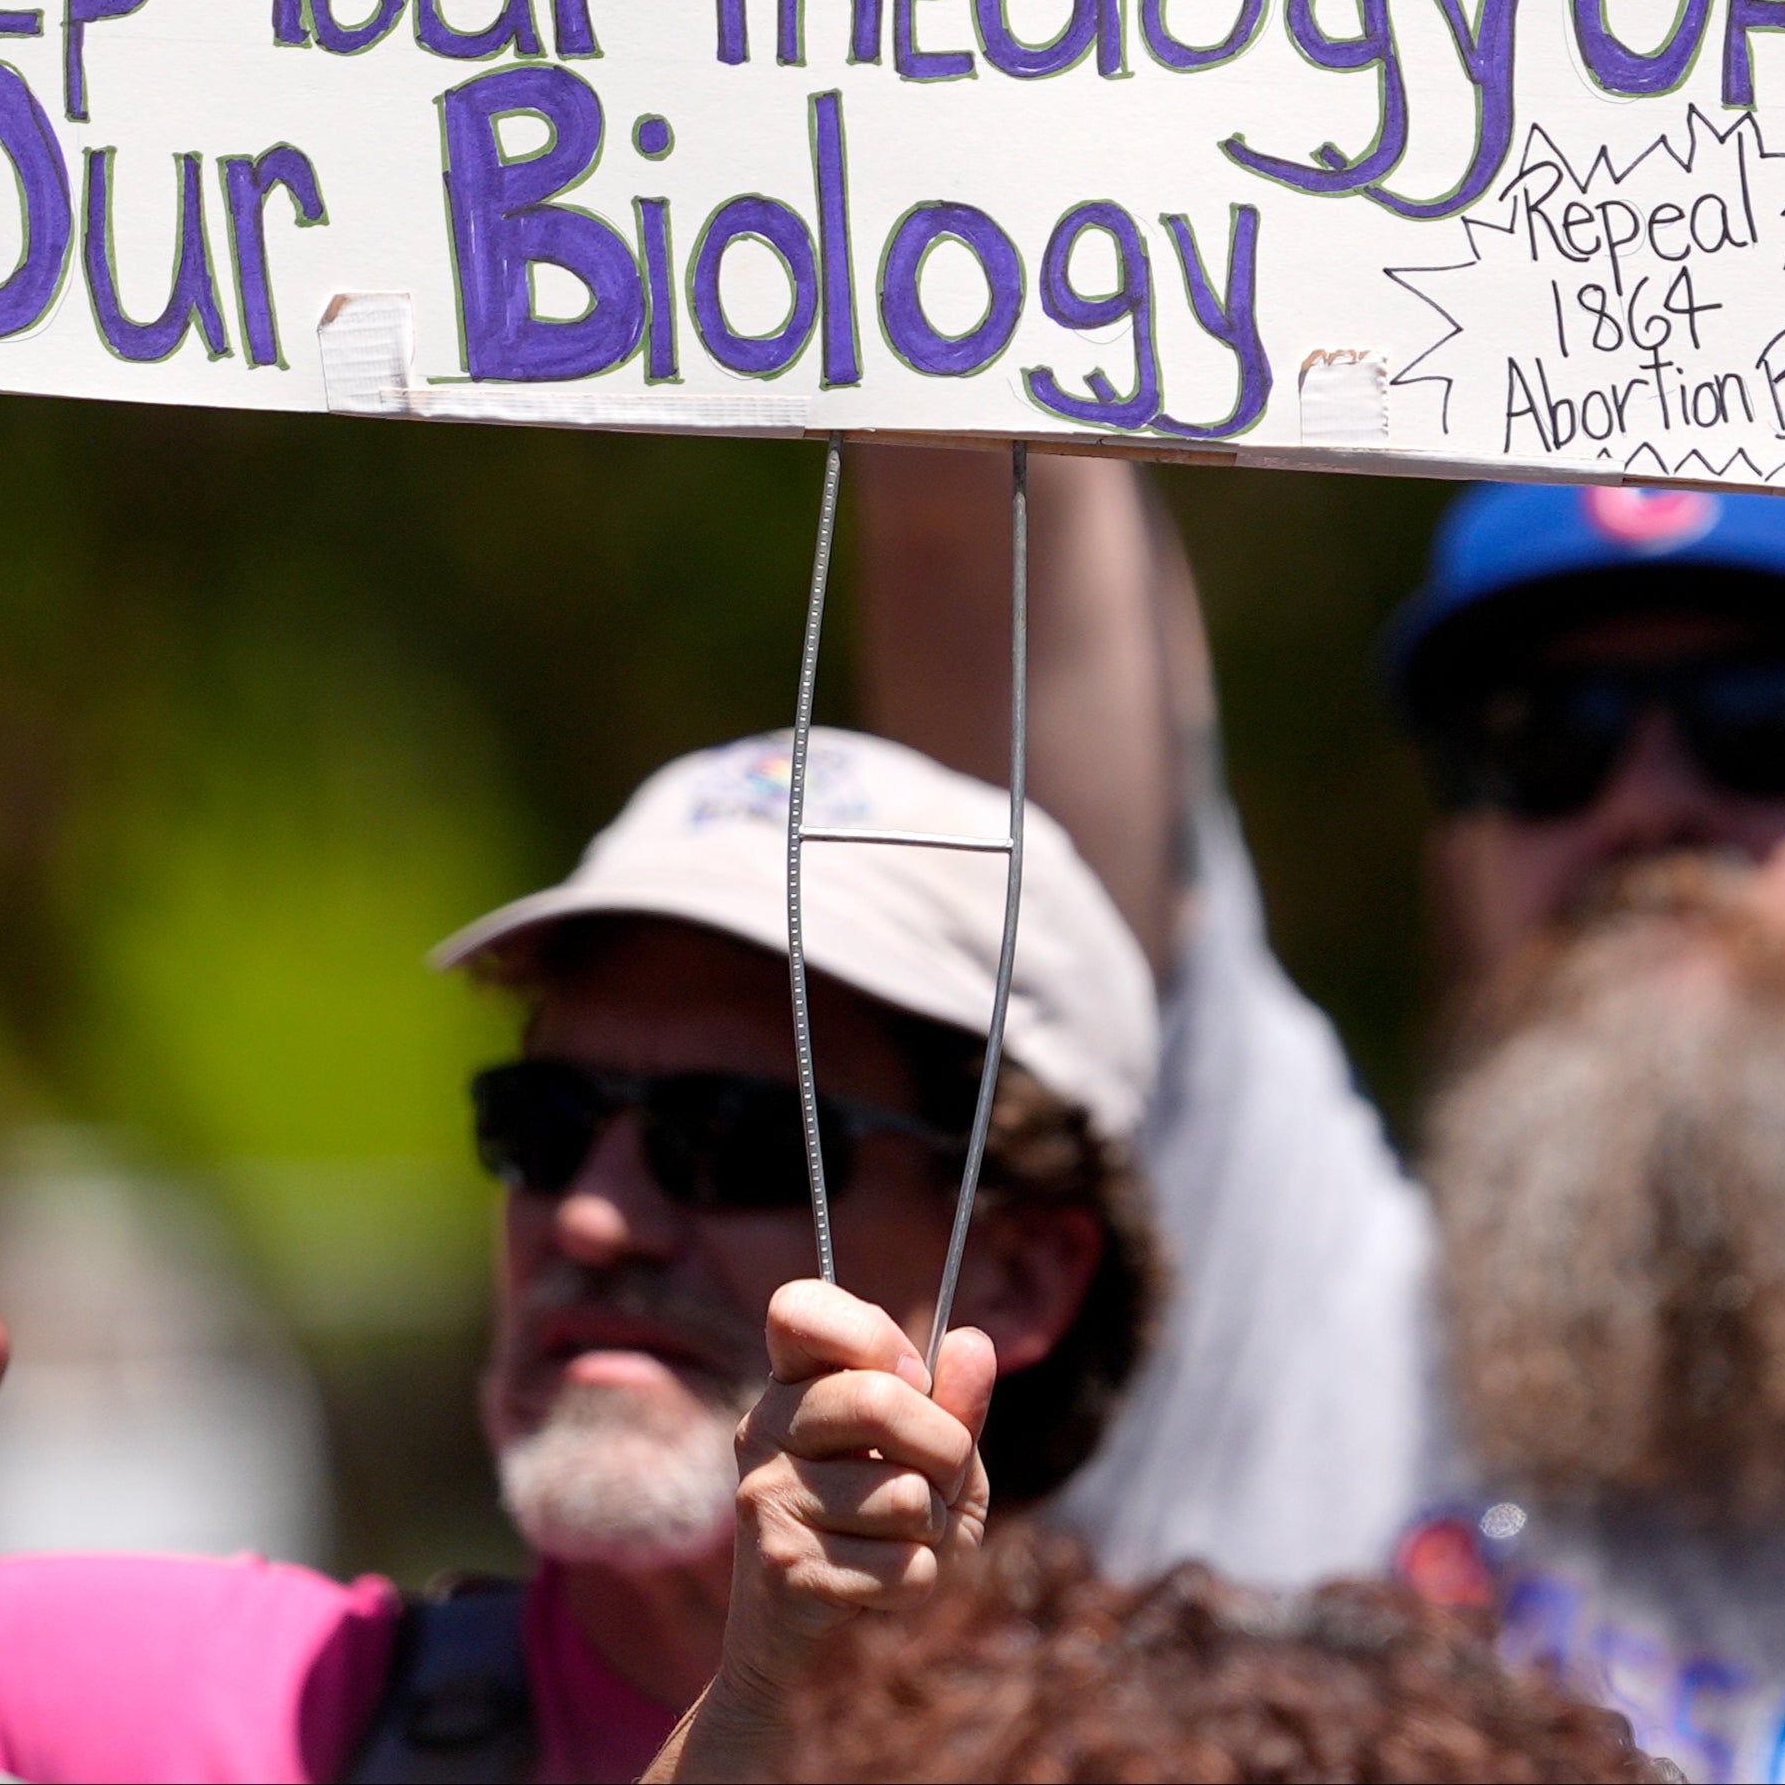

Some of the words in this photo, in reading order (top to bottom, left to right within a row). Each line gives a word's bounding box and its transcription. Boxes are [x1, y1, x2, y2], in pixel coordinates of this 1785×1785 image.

[427, 62, 1273, 439] Biology
[1499, 131, 1758, 296] Repeal
[1551, 265, 1723, 357] 1864
[1504, 346, 1754, 454] Abortion
